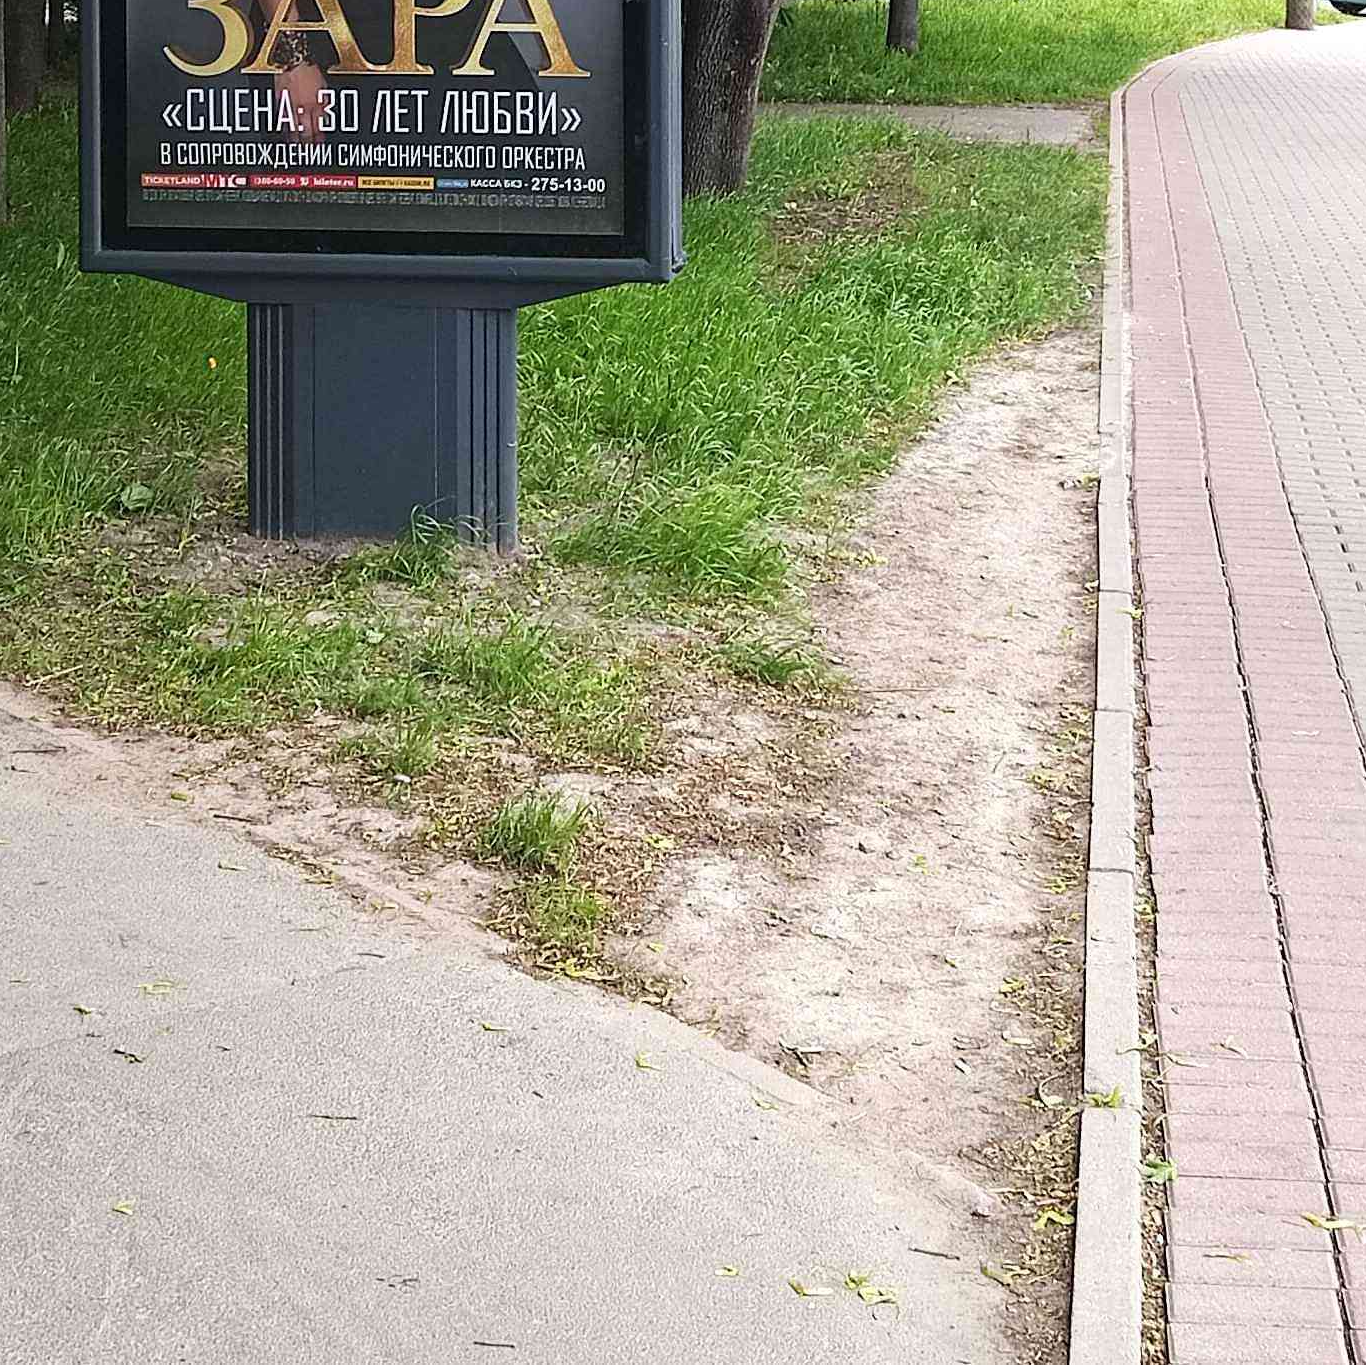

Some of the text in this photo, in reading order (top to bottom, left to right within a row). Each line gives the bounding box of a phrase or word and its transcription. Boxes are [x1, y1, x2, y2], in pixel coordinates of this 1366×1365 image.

[162, 88, 582, 135] «СЦЕНА: 30 ЛЕТ ЛЮБВИ»
[160, 143, 586, 170] В СОПРОВОЖДЕНИИ СИМФОНИЧЕСКОГО ОРКЕСТРА
[470, 178, 502, 187] КАССА
[531, 177, 606, 191] 275-13-00
